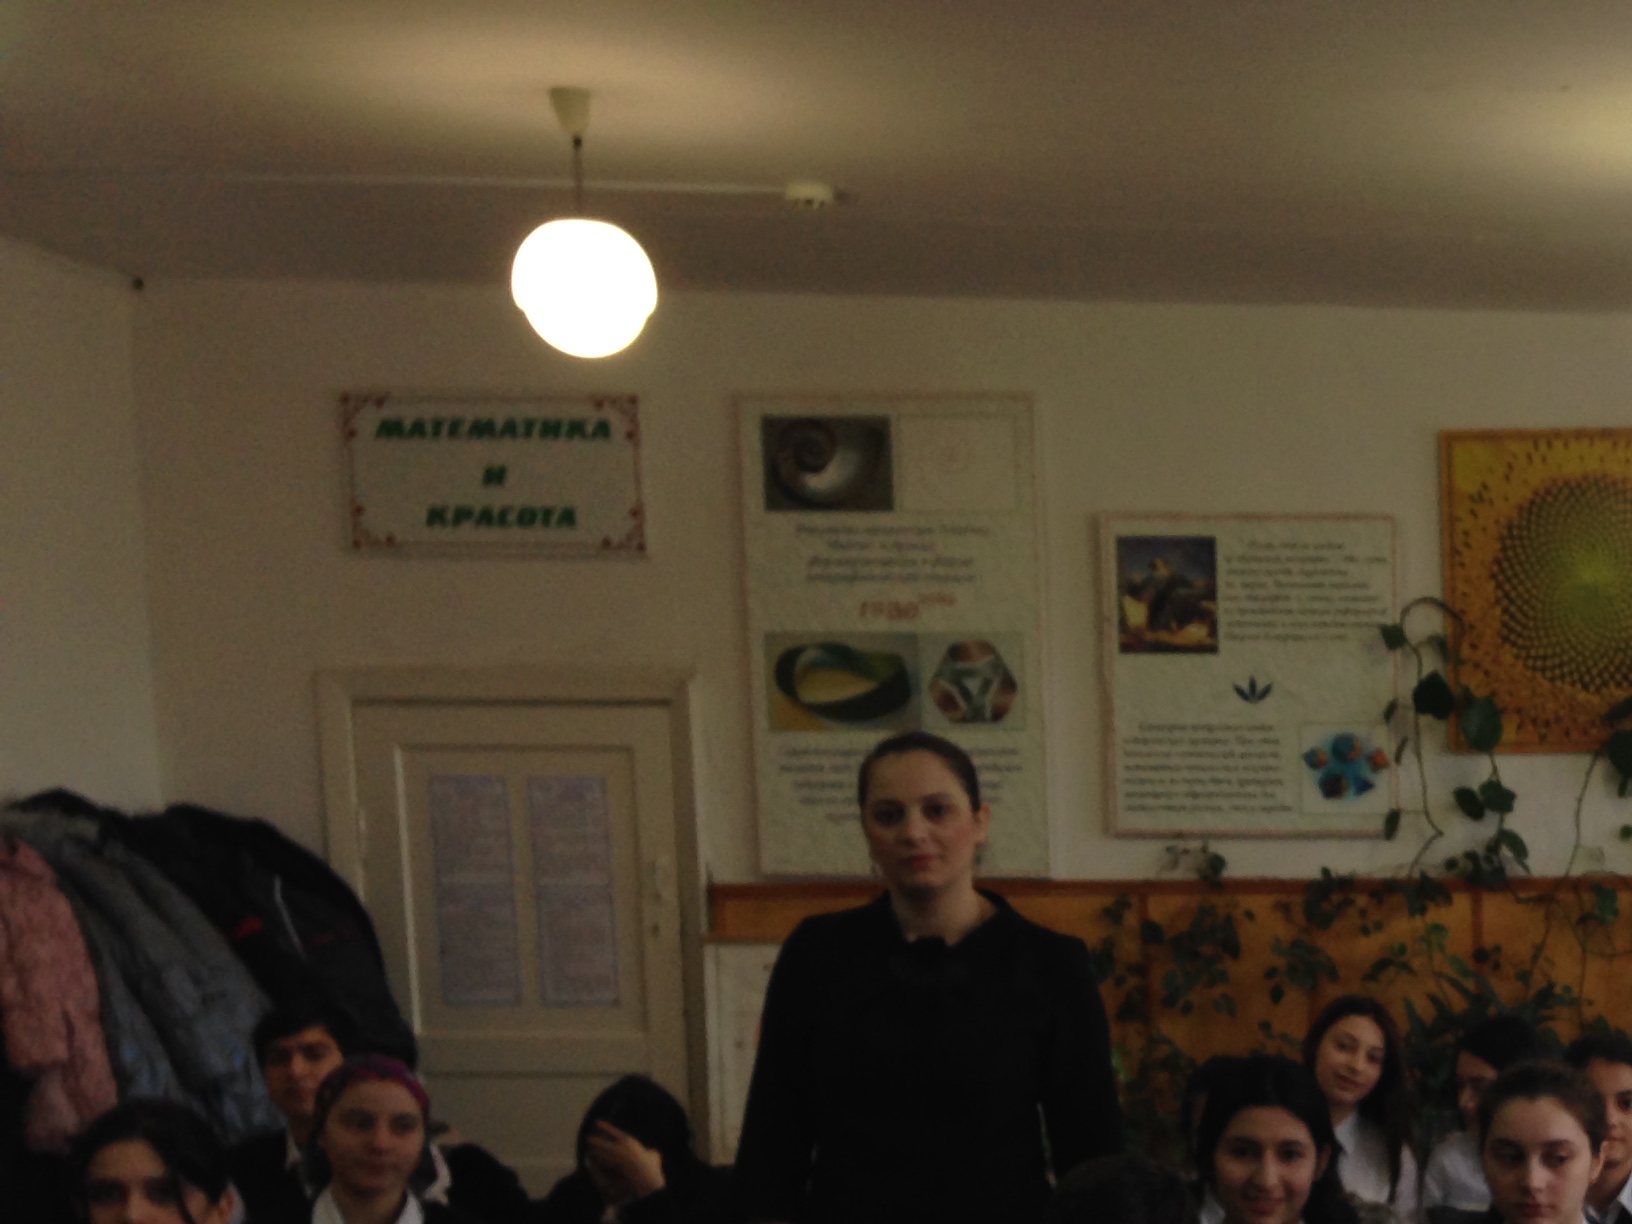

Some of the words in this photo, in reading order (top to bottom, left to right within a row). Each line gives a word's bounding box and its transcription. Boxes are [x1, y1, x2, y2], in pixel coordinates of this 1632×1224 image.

[376, 418, 611, 439] МАТЕМАТИКА
[483, 466, 507, 486] И
[426, 507, 576, 527] КРАСОТА
